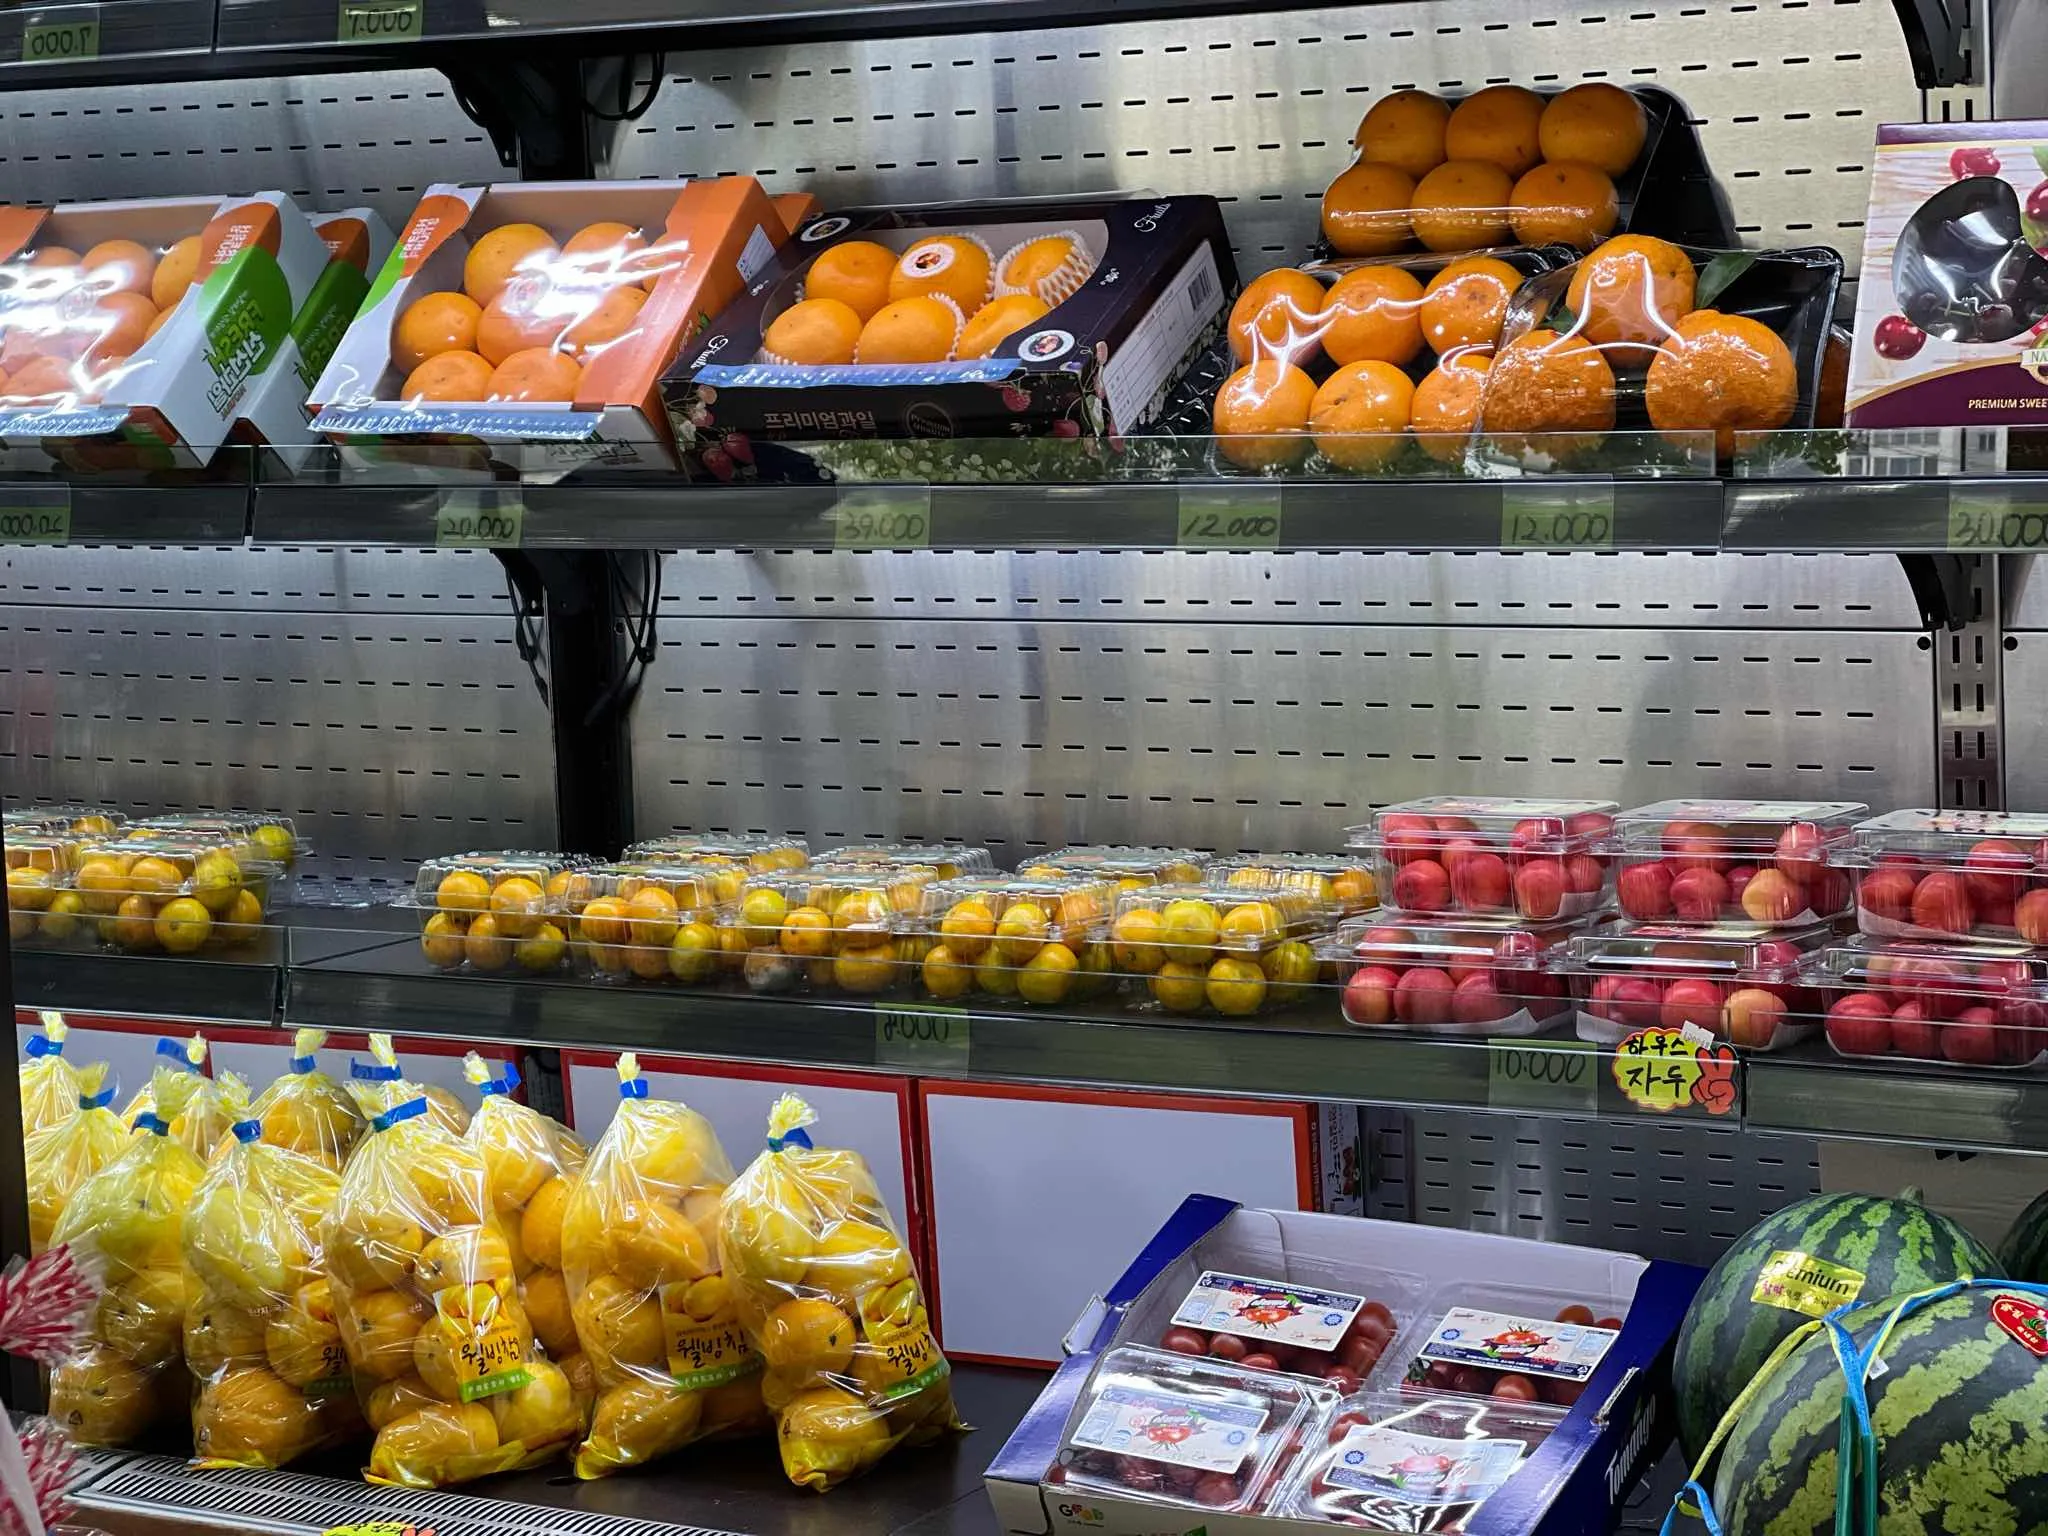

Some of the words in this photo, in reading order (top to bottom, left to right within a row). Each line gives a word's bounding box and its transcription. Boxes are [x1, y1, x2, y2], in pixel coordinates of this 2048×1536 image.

[1134, 202, 1172, 232] Fruits
[690, 334, 729, 369] Fruits
[1968, 399, 2018, 409] PREMIUM
[764, 411, 877, 430] 프리미엄과일
[1628, 1034, 1690, 1057] 하우스
[1626, 1061, 1687, 1098] 자두
